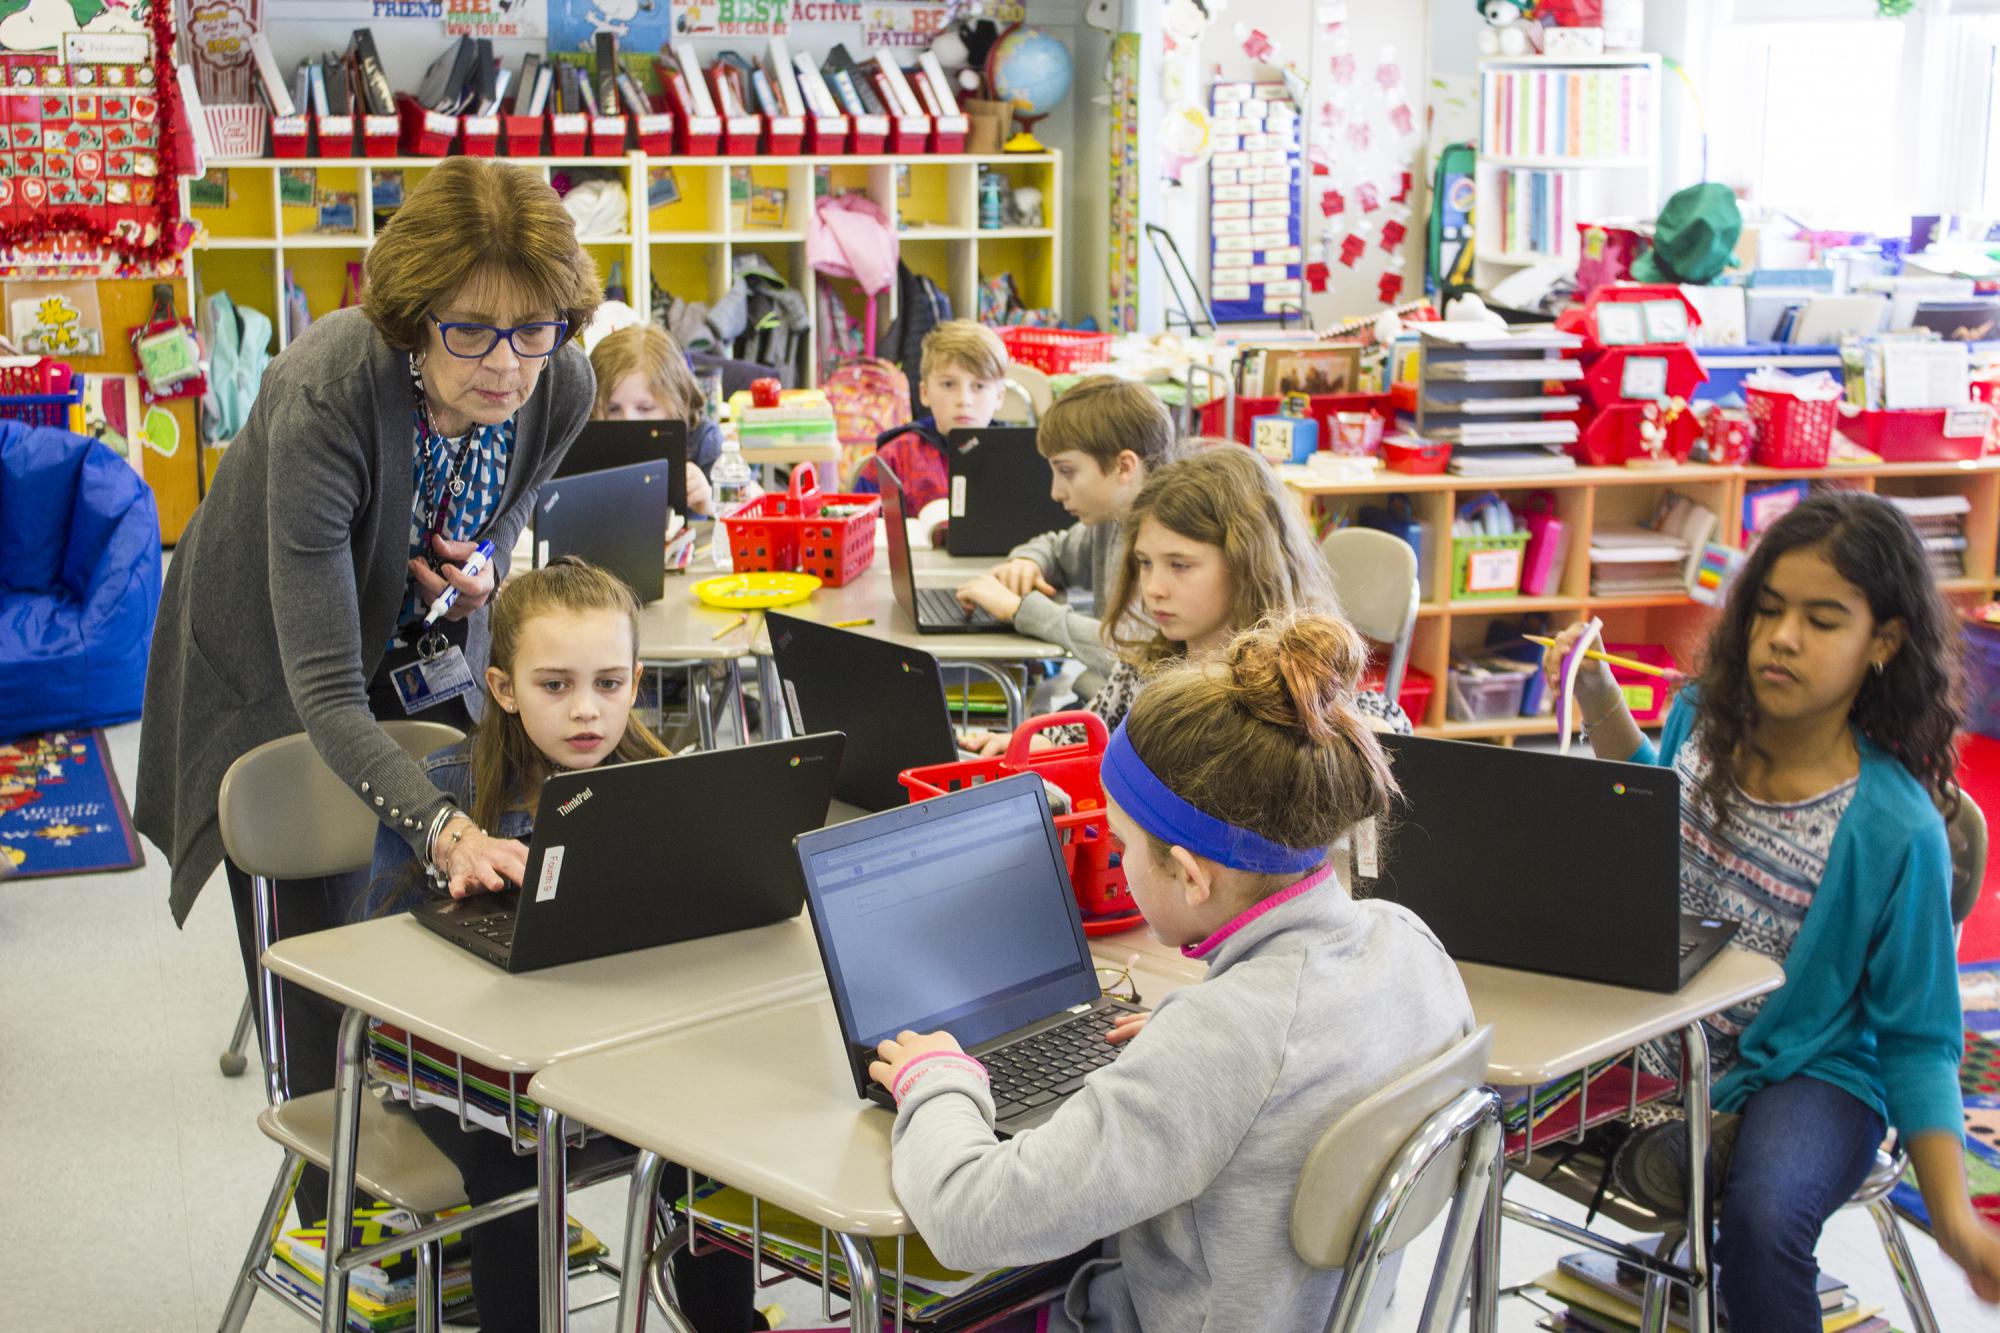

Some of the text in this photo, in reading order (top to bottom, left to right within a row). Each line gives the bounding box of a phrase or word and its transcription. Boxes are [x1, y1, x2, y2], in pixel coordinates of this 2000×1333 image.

[373, 1, 442, 17] FRIEND
[718, 0, 788, 23] BEST
[792, 3, 862, 21] ACTIVE
[719, 23, 788, 35] YOU CAN BE
[912, 9, 945, 32] BE
[448, 24, 518, 36] WHO YOU ARE
[867, 31, 935, 47] PATIEN
[1259, 424, 1288, 449] 24
[556, 786, 594, 817] ThinkPad
